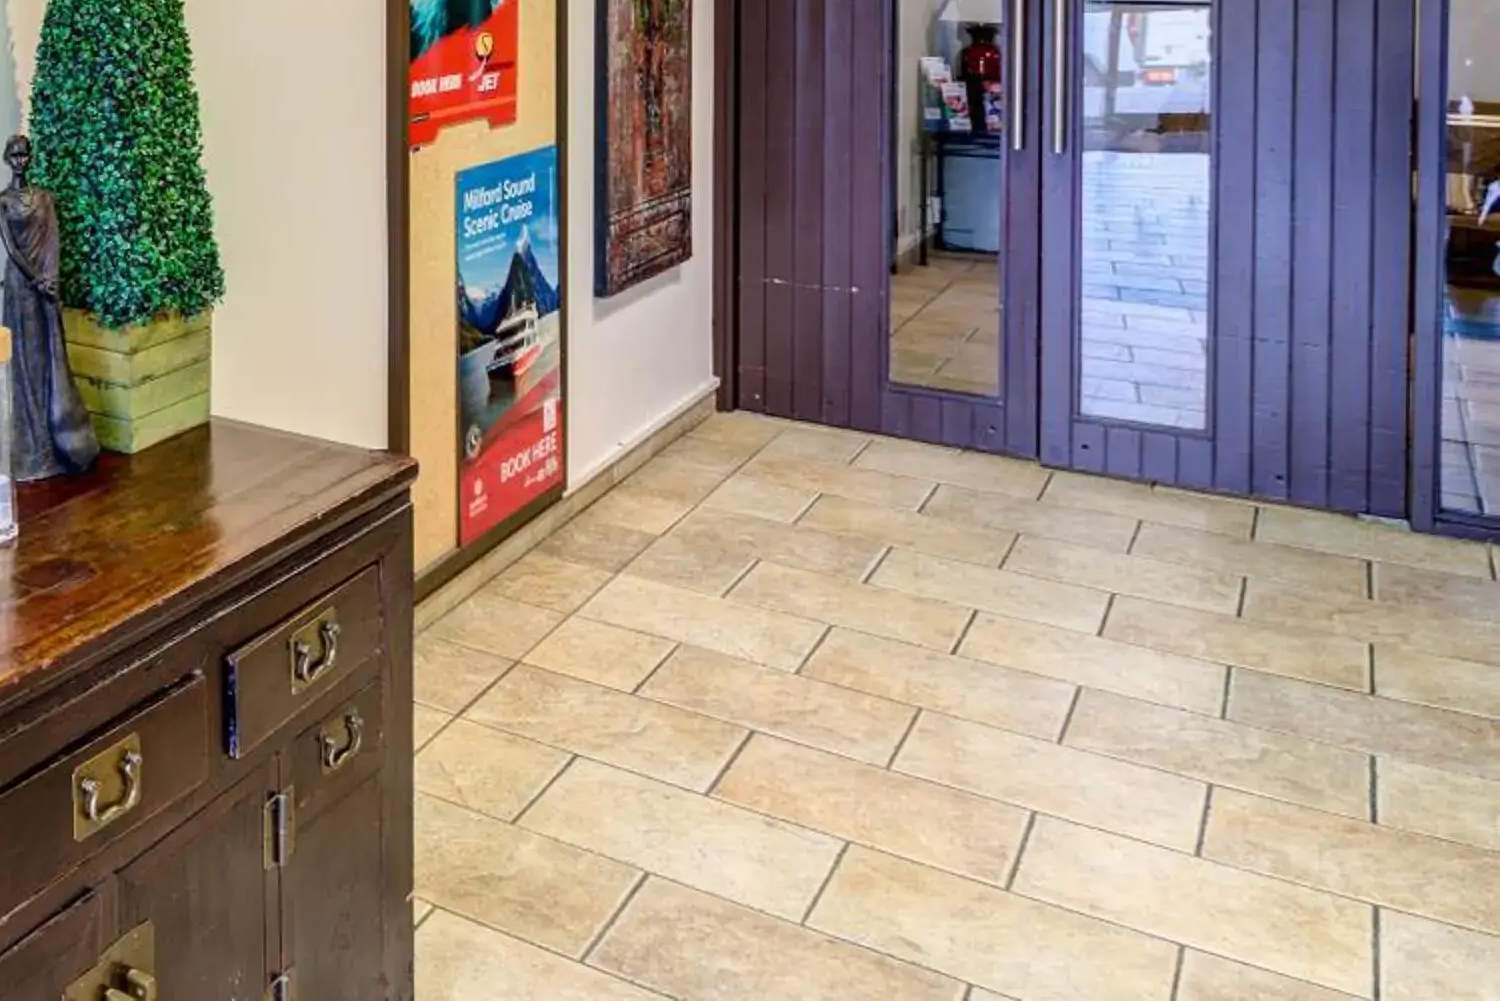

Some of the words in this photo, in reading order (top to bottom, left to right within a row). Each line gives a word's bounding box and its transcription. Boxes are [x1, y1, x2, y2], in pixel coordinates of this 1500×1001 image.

[476, 71, 501, 93] JET
[463, 181, 503, 213] Milford
[503, 172, 536, 201] Sound
[463, 209, 499, 238] Scenic
[501, 198, 533, 225] Cruise
[500, 447, 531, 484] BOOK
[532, 430, 558, 464] HERE
